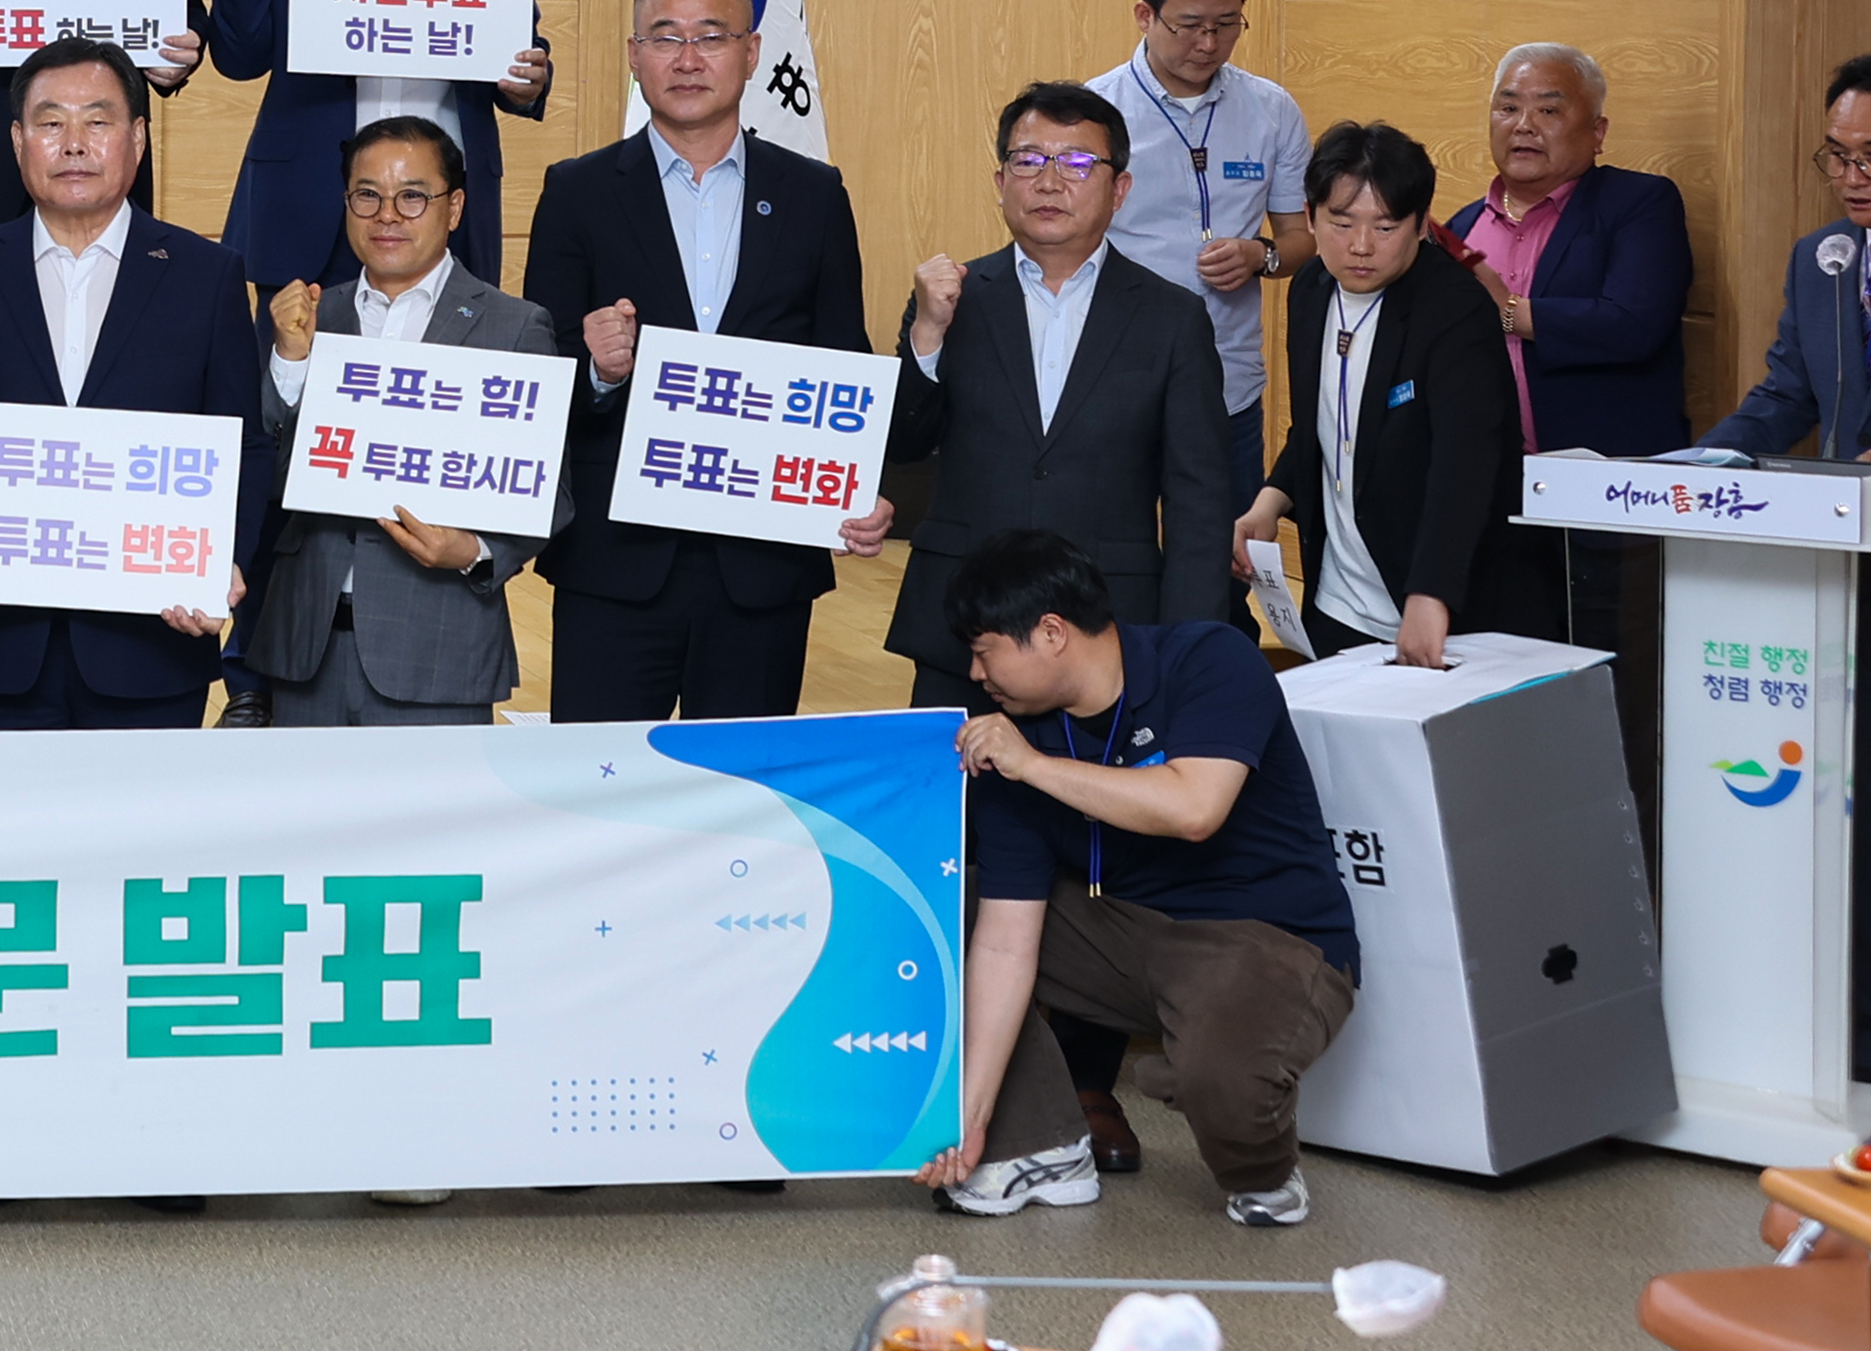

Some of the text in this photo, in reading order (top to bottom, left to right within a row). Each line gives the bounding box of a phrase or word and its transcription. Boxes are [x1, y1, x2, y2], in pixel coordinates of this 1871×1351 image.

[122, 18, 159, 49] 날!
[345, 17, 473, 56] 하는 날!
[336, 362, 539, 421] 투표는 힘!
[653, 361, 874, 433] 투표는 희망
[127, 446, 218, 496] 희망
[309, 426, 546, 497] 꼭 투표 합시다
[640, 438, 859, 510] 투표는 변화
[1697, 482, 1769, 519] 장흥
[123, 524, 211, 576] 변화
[1267, 603, 1297, 633] 용지
[1703, 640, 1808, 675] 친절 행정
[1703, 673, 1808, 709] 청렴 행정
[123, 874, 492, 1058] 발표
